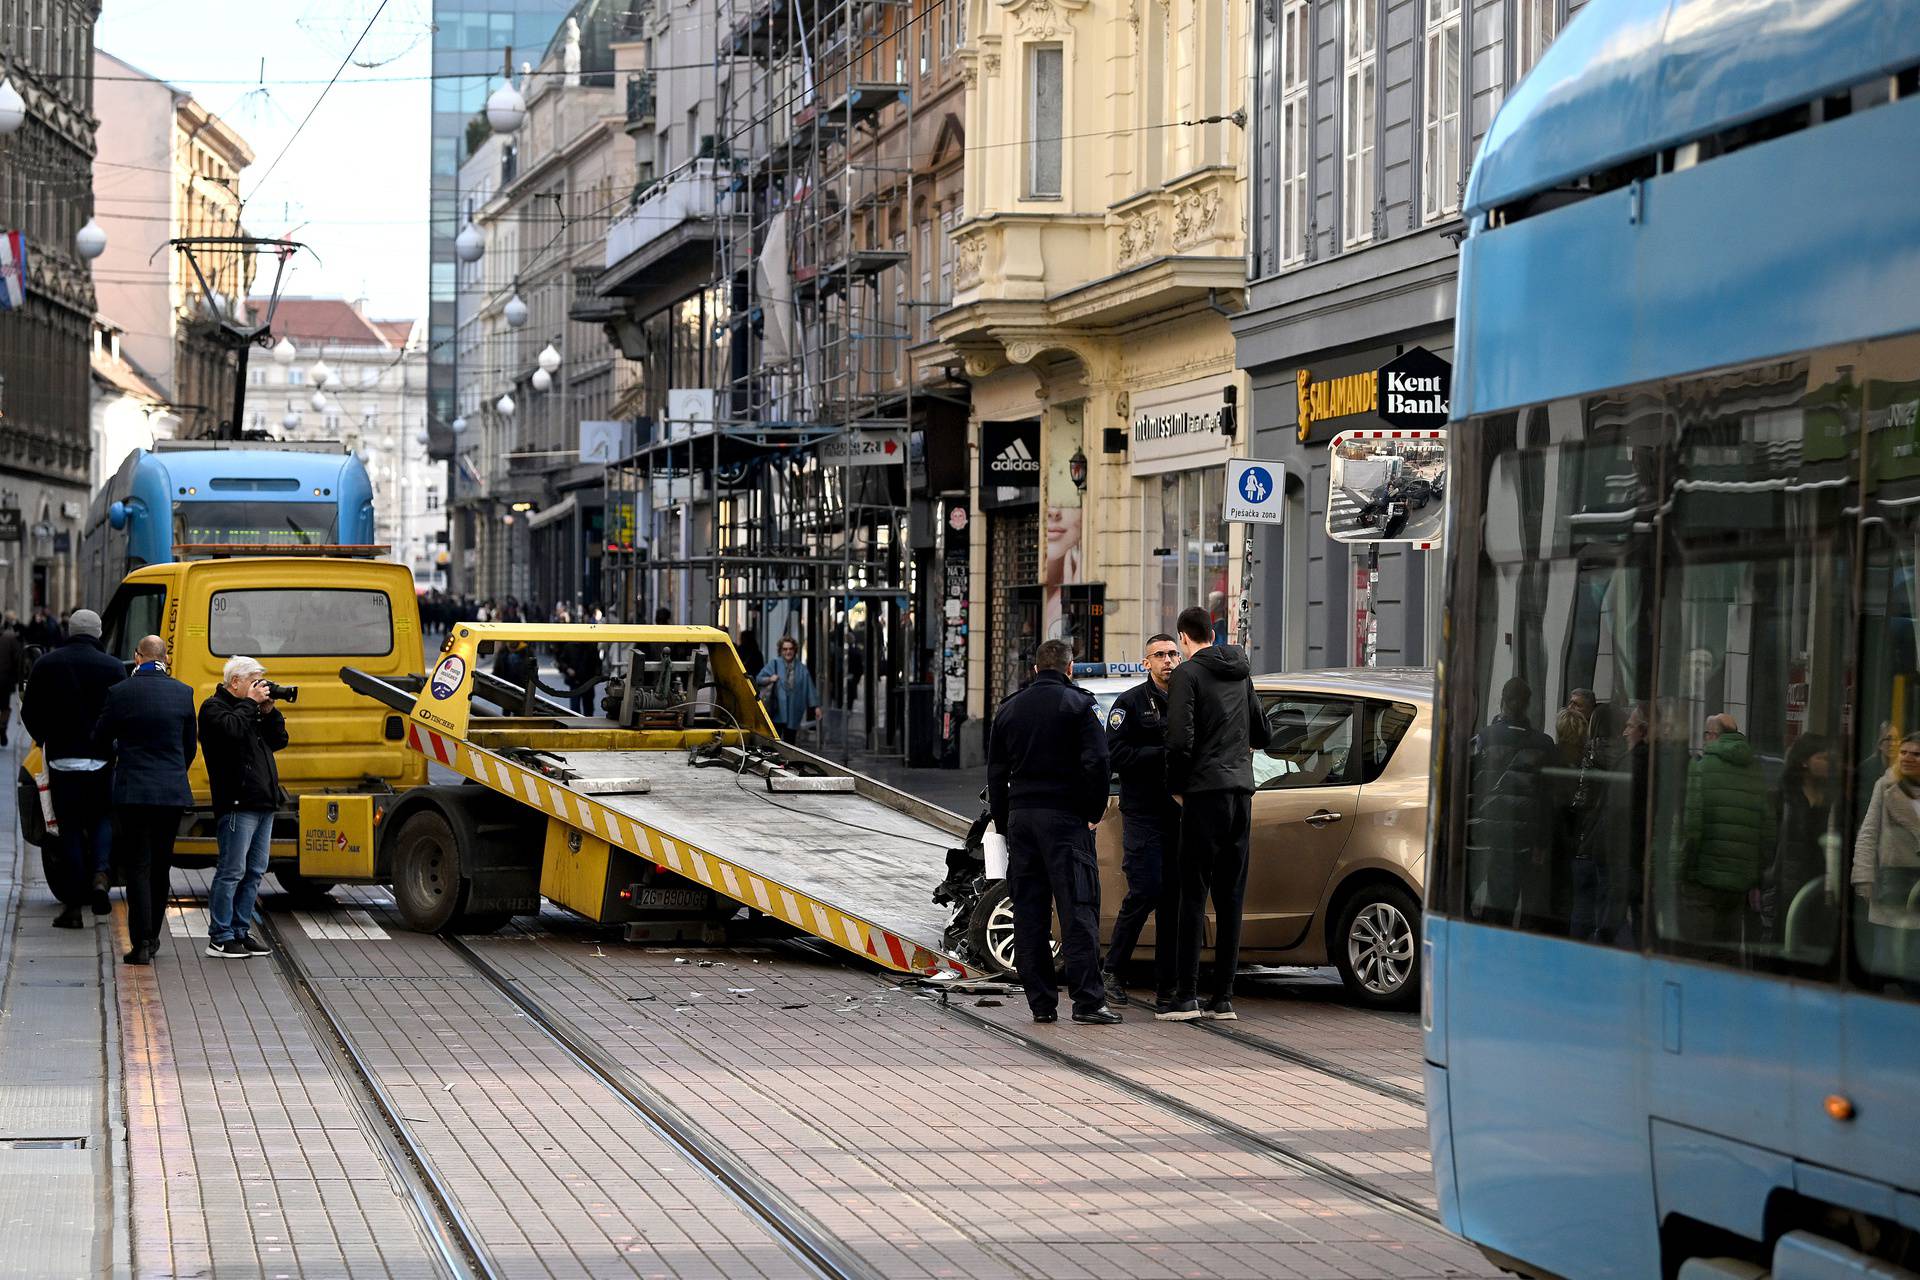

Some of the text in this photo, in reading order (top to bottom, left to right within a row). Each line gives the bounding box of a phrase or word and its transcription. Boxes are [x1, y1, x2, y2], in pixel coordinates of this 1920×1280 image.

[1388, 372, 1441, 392] Kent
[1388, 394, 1449, 414] Bank
[991, 458, 1039, 471] adidas
[1262, 511, 1276, 519] zona
[213, 597, 227, 611] 90
[372, 595, 385, 607] HR
[169, 598, 179, 632] CESTI
[167, 634, 175, 655] NA
[1110, 663, 1149, 673] POLIC
[305, 829, 336, 838] AUTOKLUB
[305, 839, 336, 851] SIGET
[641, 889, 657, 905] ZG
